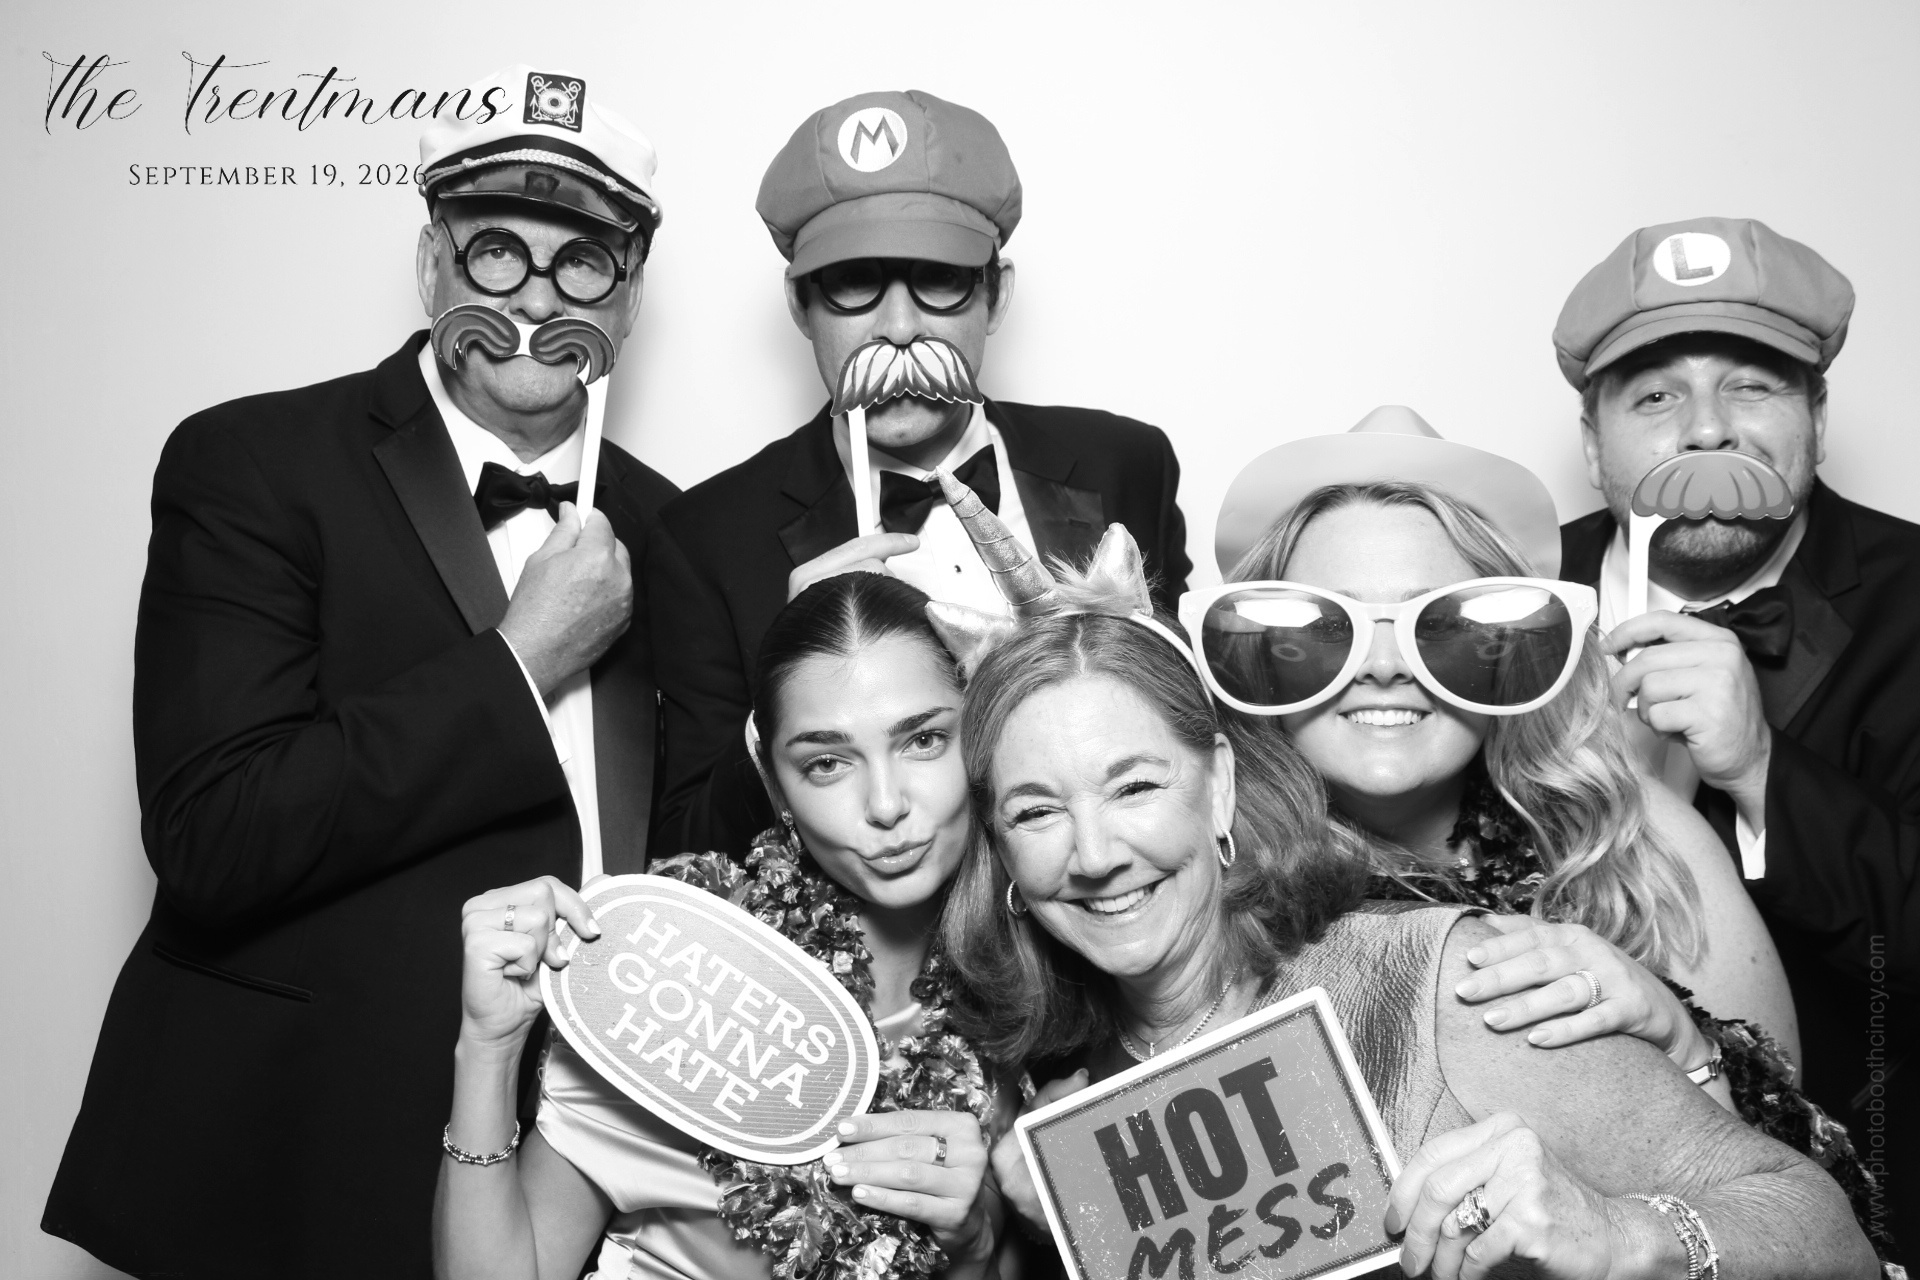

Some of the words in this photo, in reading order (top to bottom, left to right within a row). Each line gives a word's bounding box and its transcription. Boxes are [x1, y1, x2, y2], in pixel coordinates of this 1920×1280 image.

[851, 115, 899, 164] M
[1670, 238, 1714, 280] L
[608, 952, 811, 1109] GONNA
[626, 908, 836, 1065] HATERS
[605, 1004, 759, 1123] HATE
[1093, 1056, 1300, 1233] HOT
[1126, 1162, 1356, 1280] MESS
